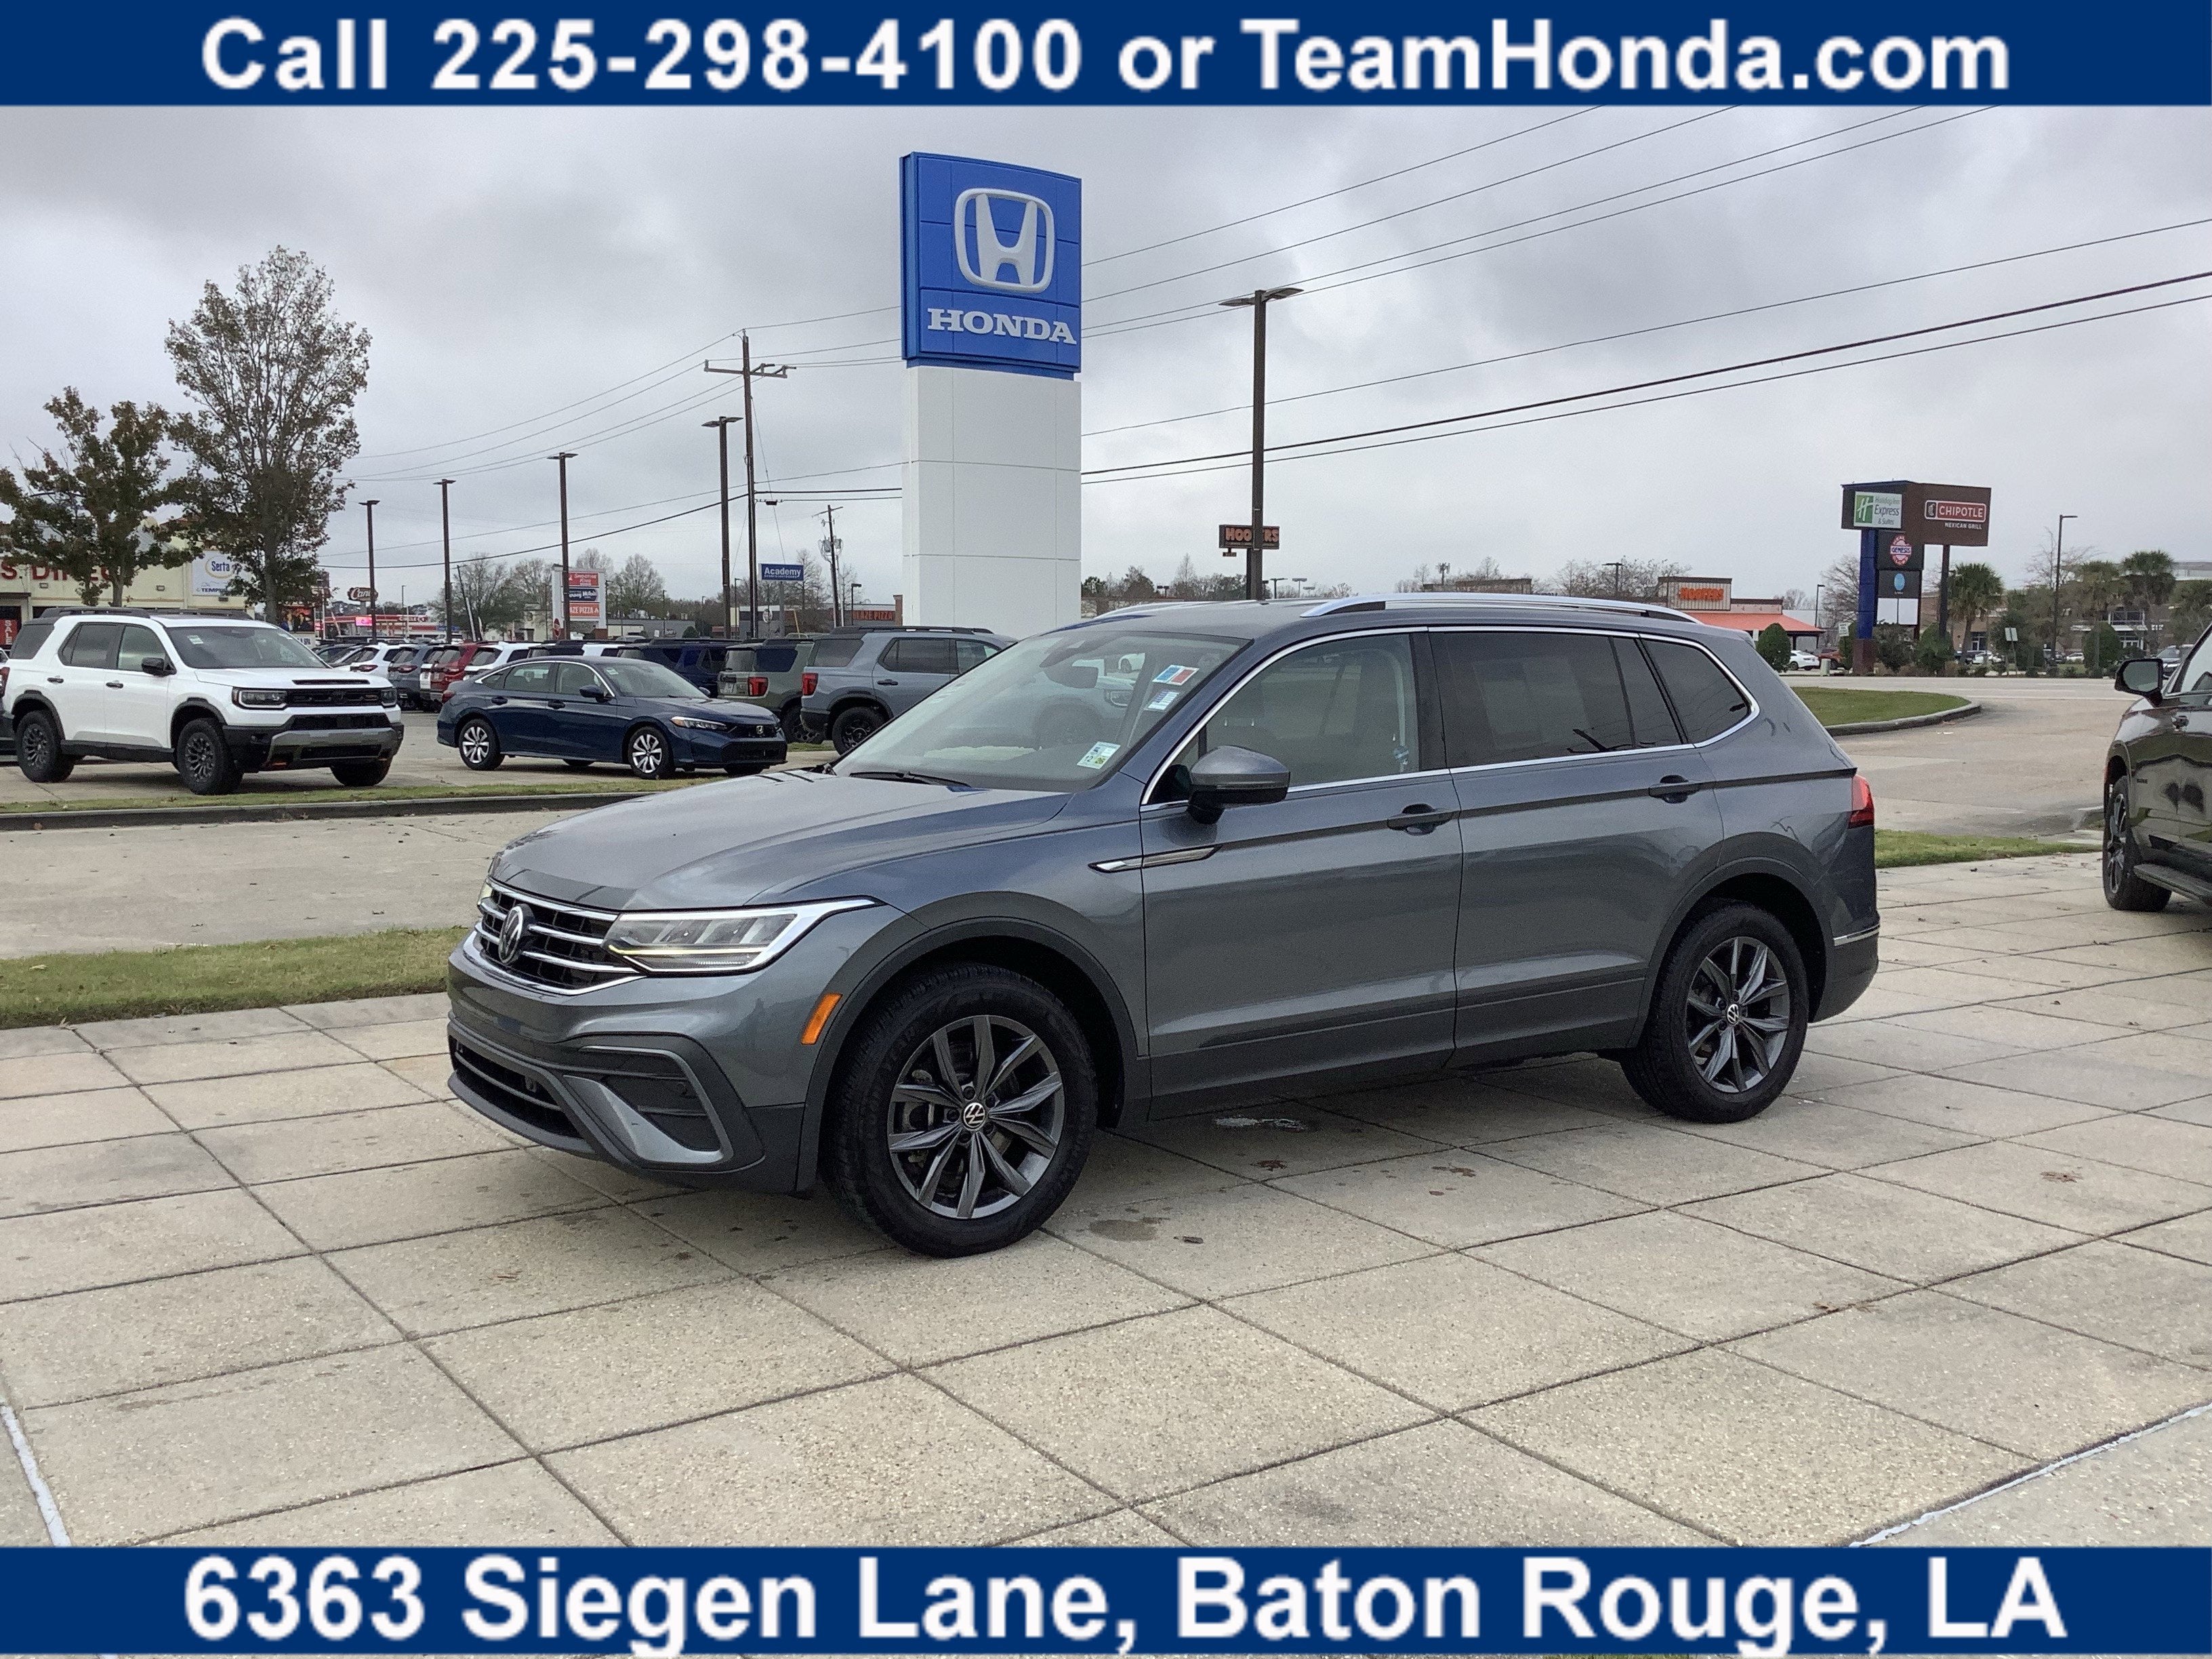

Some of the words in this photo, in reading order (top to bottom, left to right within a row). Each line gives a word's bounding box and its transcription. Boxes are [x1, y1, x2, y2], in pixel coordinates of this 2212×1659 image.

[927, 308, 1077, 345] HONDA
[1874, 504, 1900, 517] Express
[1939, 505, 1984, 518] CHIPOTLE
[1225, 527, 1279, 542] HOORS
[211, 560, 230, 572] Serta
[764, 567, 802, 578] Academy
[874, 610, 893, 621] PIZZA
[5, 619, 13, 645] SALE
